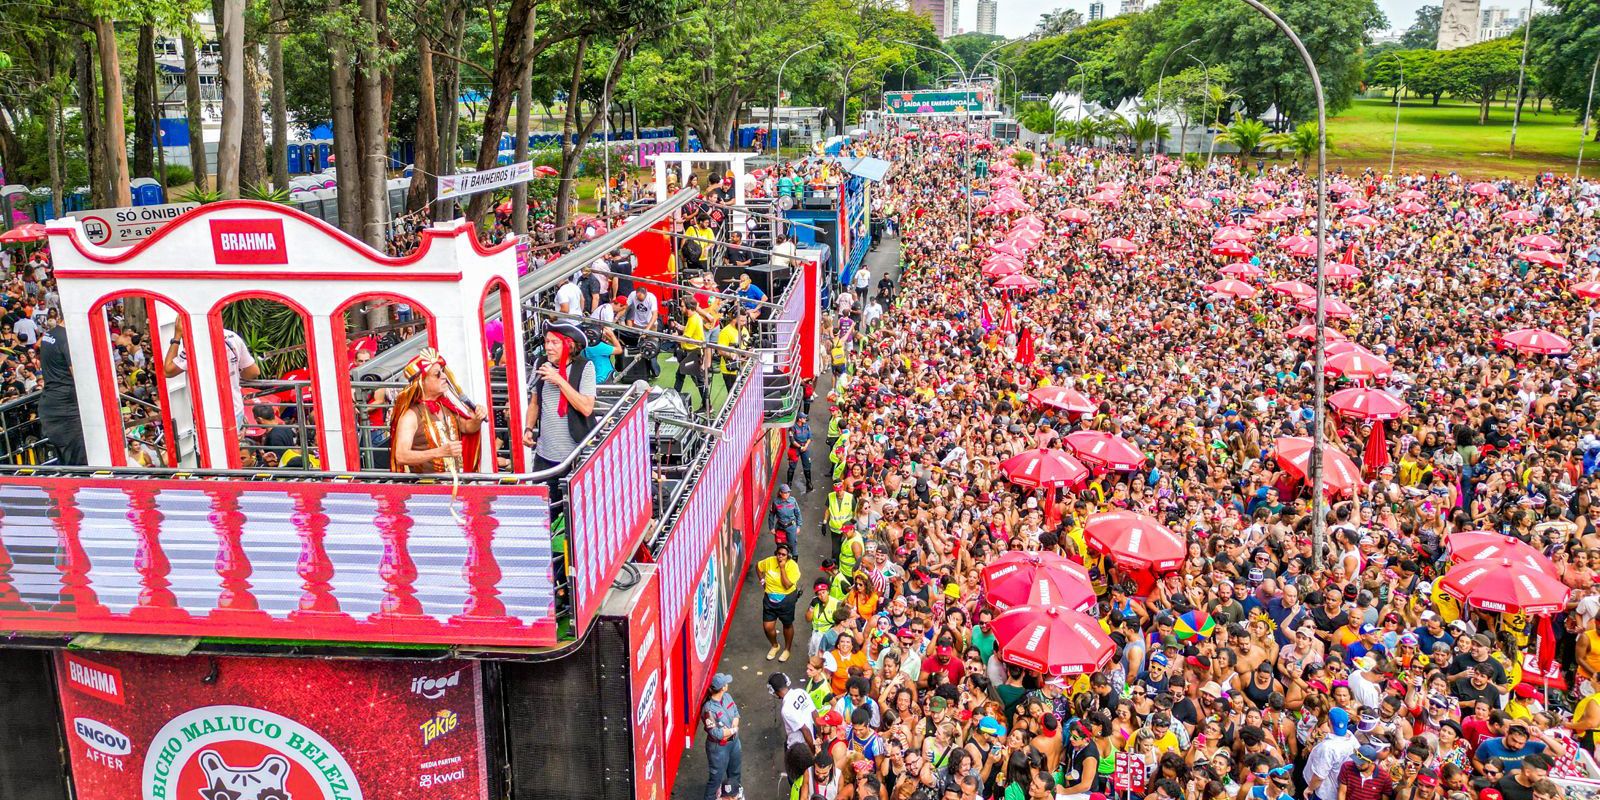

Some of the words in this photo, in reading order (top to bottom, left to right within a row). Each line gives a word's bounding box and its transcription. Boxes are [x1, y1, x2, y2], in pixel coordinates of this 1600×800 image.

[470, 169, 508, 187] BANHEIROS
[116, 208, 137, 222] SÓ
[120, 228, 131, 237] 2ª
[221, 233, 277, 250] BRAHMA
[990, 564, 1018, 580] BRAHMA
[1481, 600, 1506, 611] BRAHMA
[1061, 664, 1083, 673] BRAHMA
[69, 660, 118, 696] BRAHMA
[638, 672, 657, 720] ENGOV
[76, 721, 127, 751] ENGOV
[420, 712, 458, 745] Takis
[85, 748, 124, 772] AFTER
[153, 737, 183, 800] BICHO
[180, 716, 282, 743] MALUCO
[285, 731, 353, 800] BELEZ
[420, 761, 437, 769] MEDIA
[437, 756, 462, 766] PARTNER
[433, 768, 465, 784] kwai
